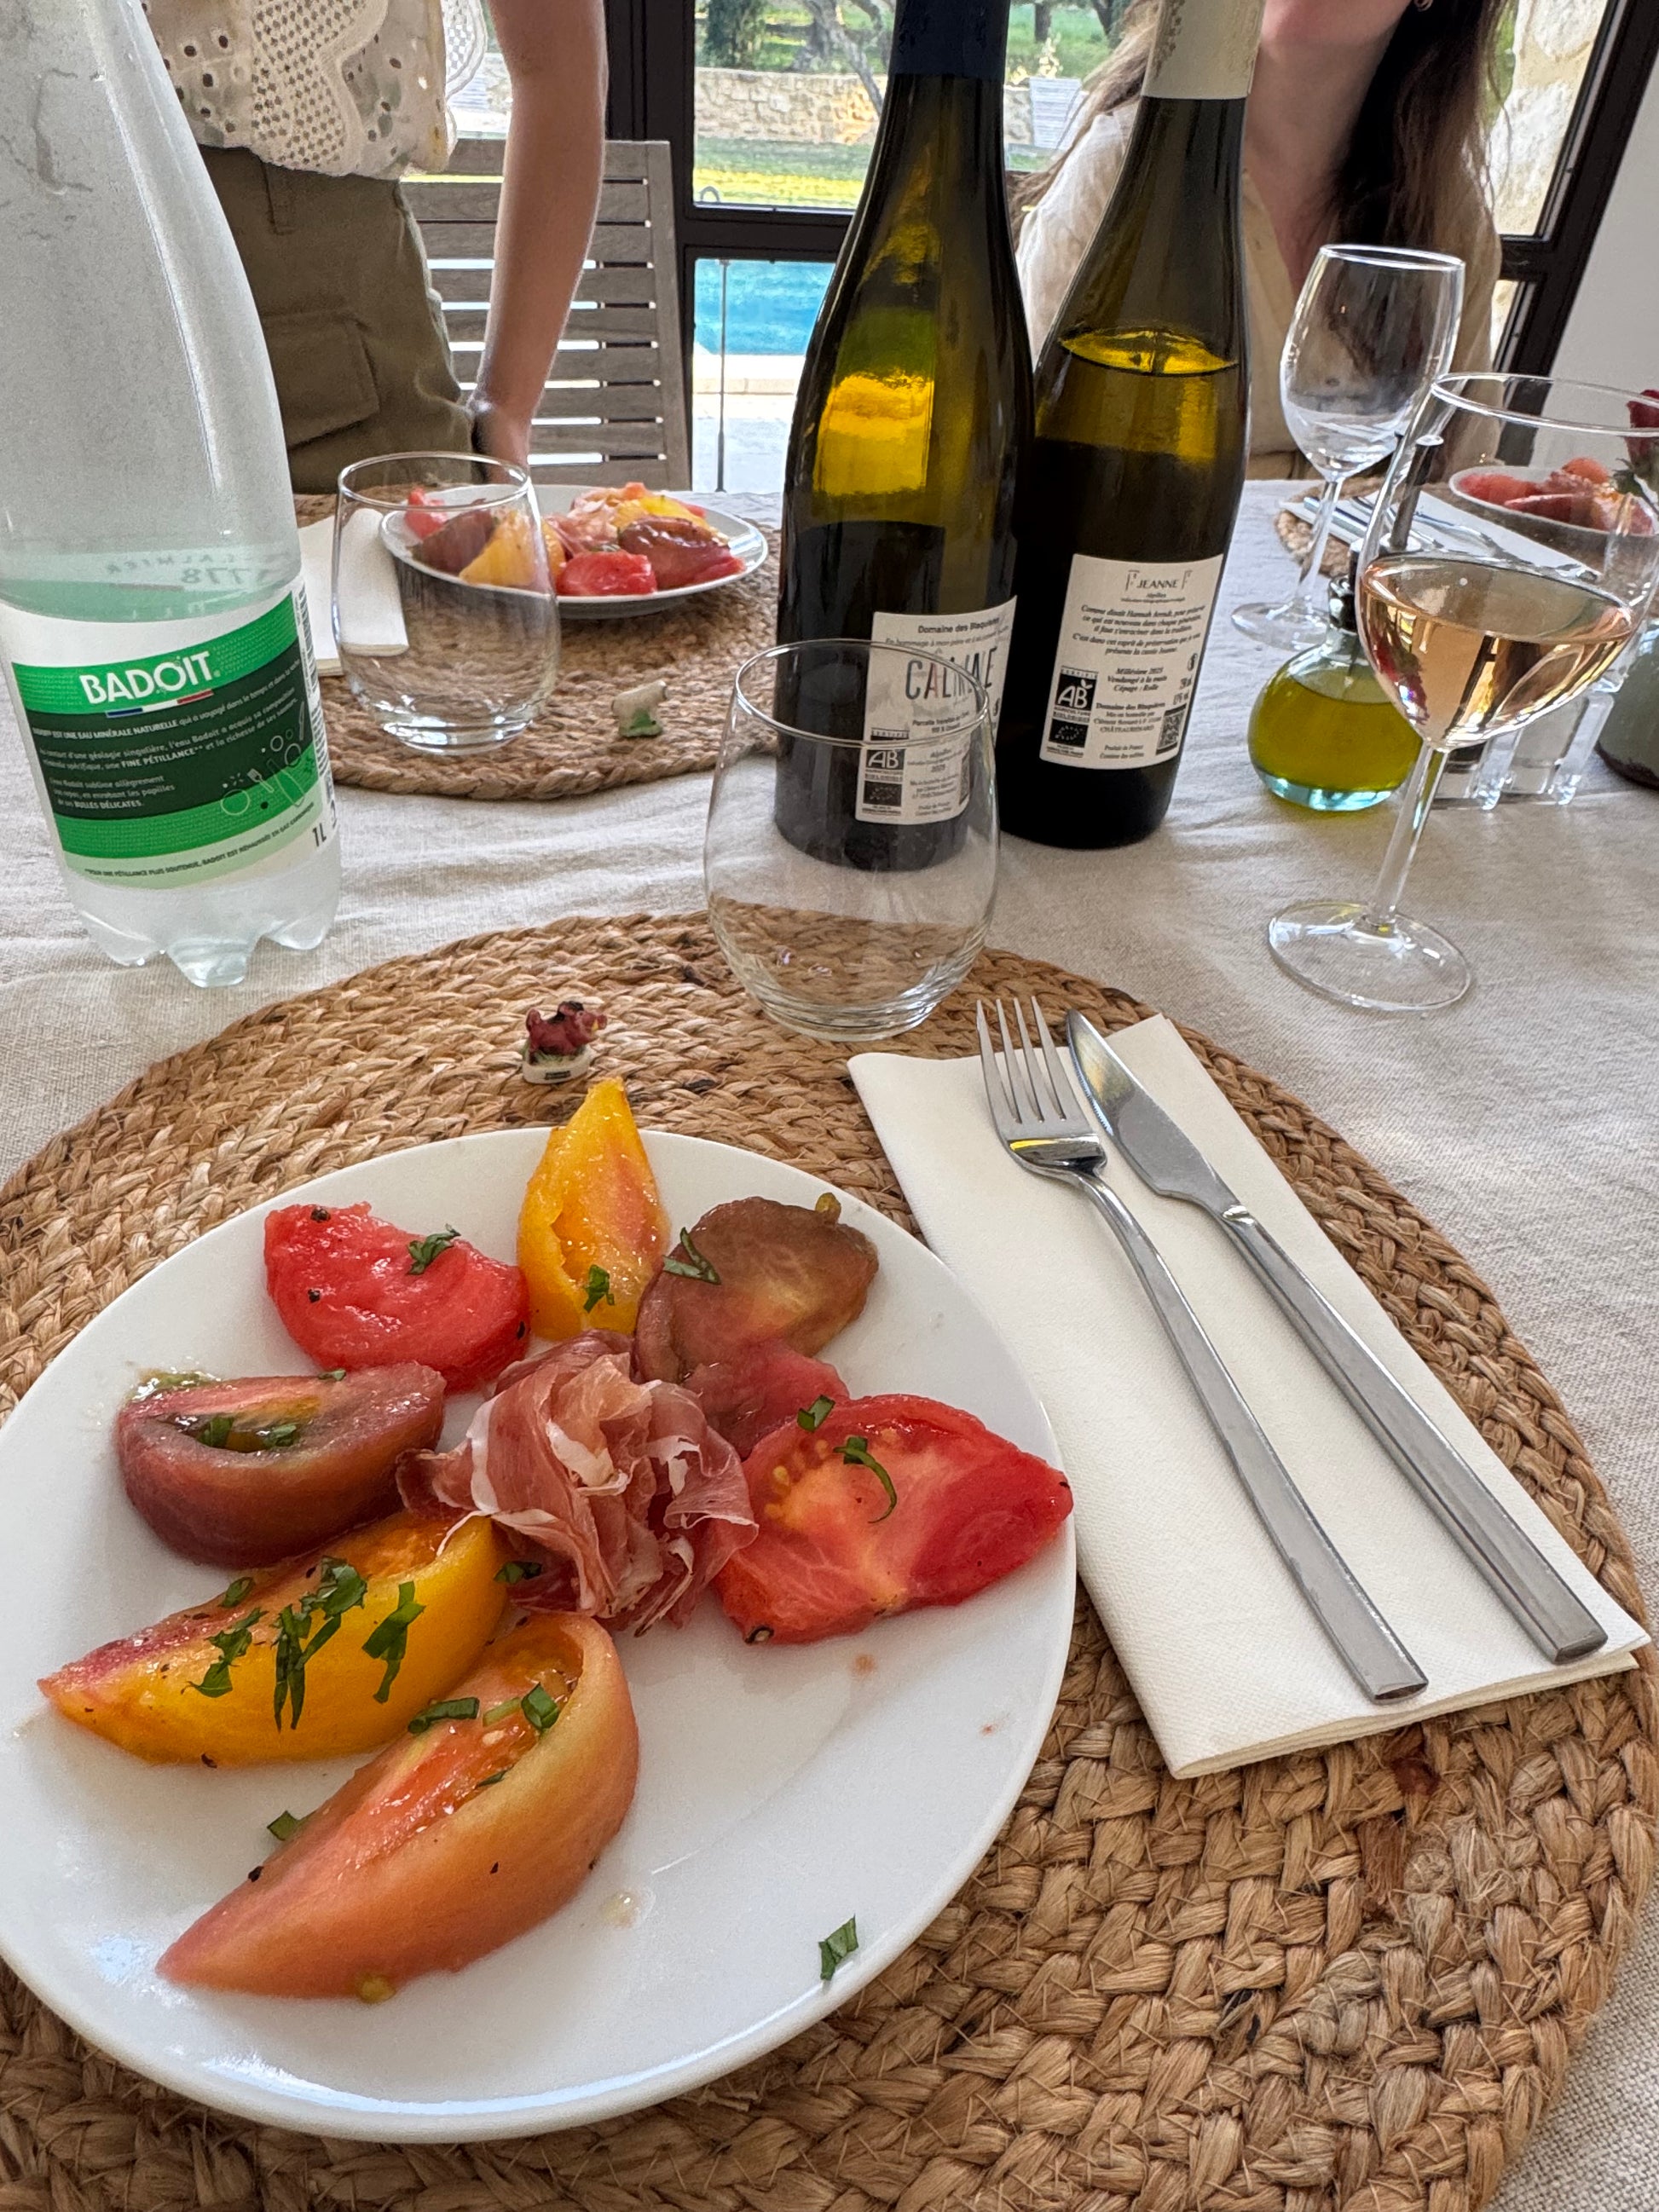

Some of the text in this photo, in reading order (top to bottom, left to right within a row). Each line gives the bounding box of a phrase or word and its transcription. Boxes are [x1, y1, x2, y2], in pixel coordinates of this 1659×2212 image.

[1136, 580, 1178, 589] JEANNE
[917, 625, 954, 633] Domaine
[954, 624, 968, 632] des
[79, 650, 213, 705] BADOIT
[1057, 685, 1088, 708] AB
[77, 731, 93, 740] EAU
[93, 728, 134, 740] MINÉRALE
[133, 719, 179, 735] NATURELLE
[178, 717, 193, 726] qui
[199, 703, 226, 719] voyagé
[227, 698, 244, 710] dans
[168, 739, 192, 749] l'eau
[191, 729, 221, 743] Badoit
[228, 715, 253, 731] acquis
[120, 759, 143, 768] FINE
[205, 742, 215, 751] et
[225, 726, 256, 743] richesse
[868, 750, 900, 769] AB
[141, 784, 176, 798] papilles
